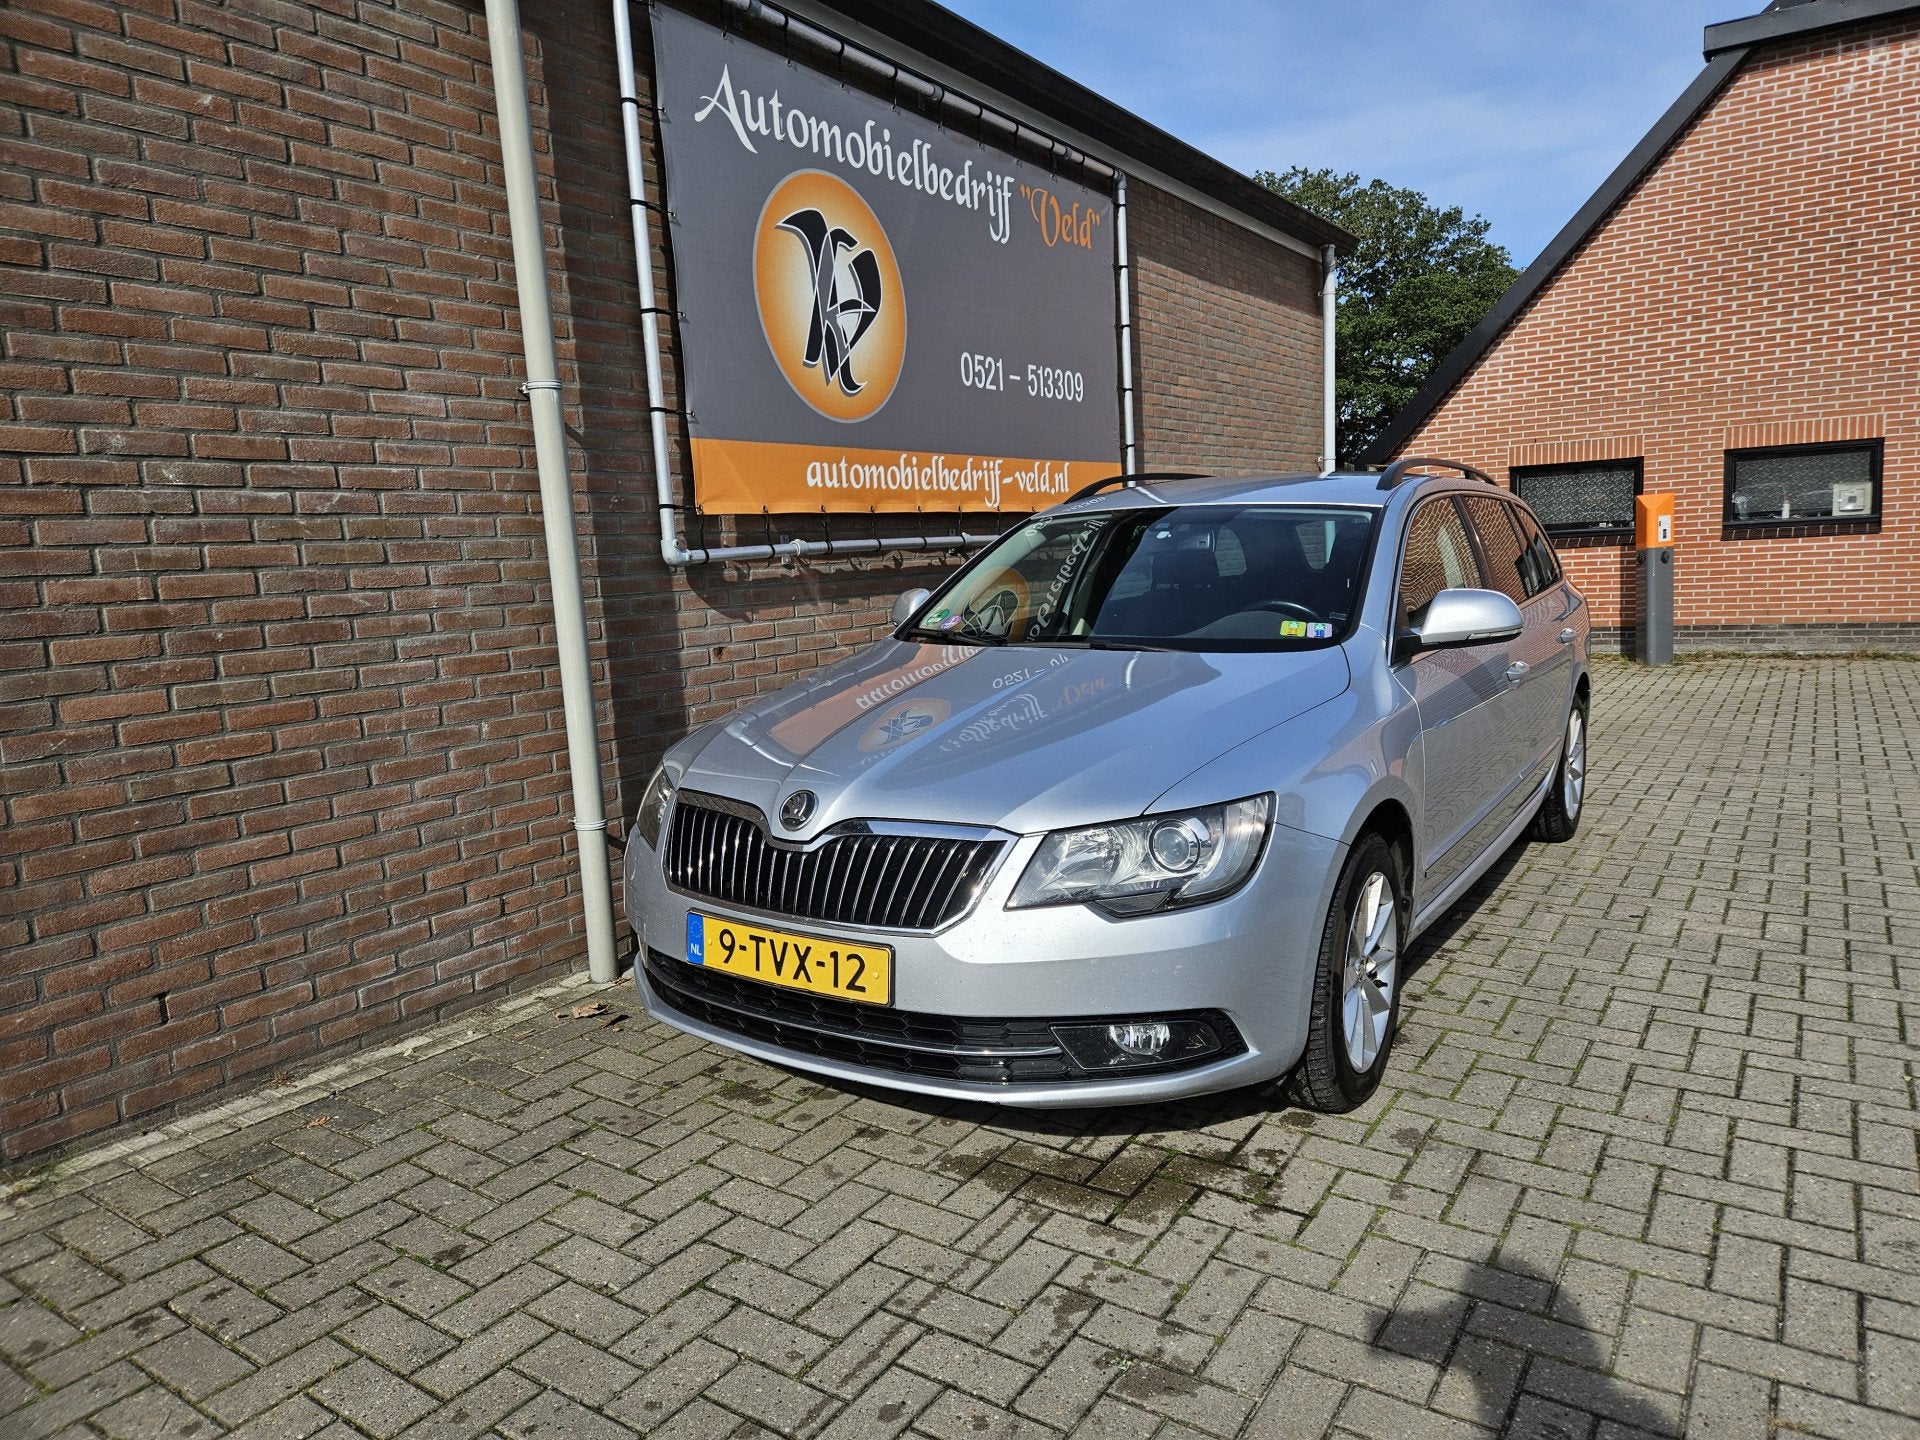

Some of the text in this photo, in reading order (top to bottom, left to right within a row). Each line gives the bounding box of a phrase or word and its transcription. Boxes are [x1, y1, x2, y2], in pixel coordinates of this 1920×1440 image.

[694, 63, 1015, 244] Automobielbedrijf
[960, 351, 1004, 391] 0521
[1027, 364, 1084, 402] 513309
[806, 453, 1070, 508] automobielbedrijf-veld.nl
[690, 942, 702, 956] NL
[719, 928, 866, 993] 9-TVX-12
